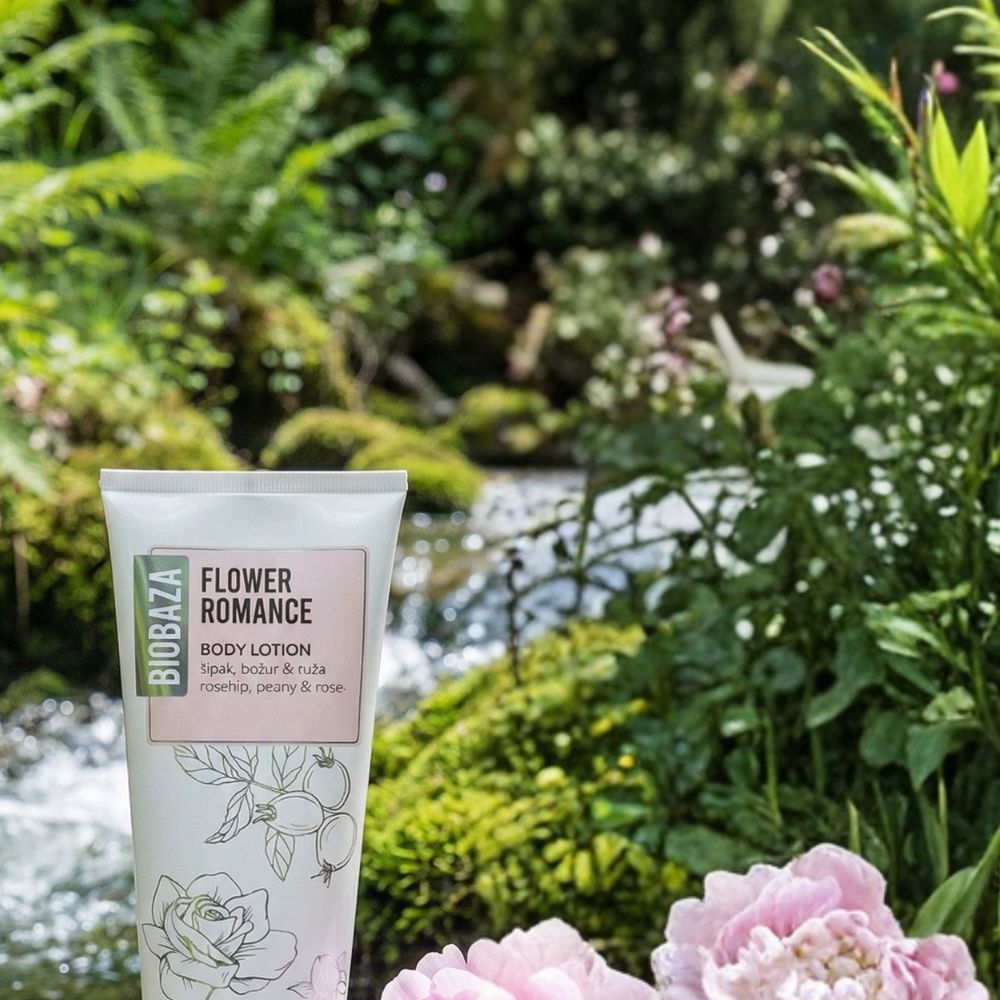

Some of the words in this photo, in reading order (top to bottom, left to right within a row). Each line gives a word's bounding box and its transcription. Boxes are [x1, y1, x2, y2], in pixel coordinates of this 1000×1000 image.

[201, 567, 291, 593] FLOWER
[201, 598, 312, 624] ROMANCE
[148, 568, 182, 686] BIOBAZA
[200, 643, 246, 656] BODY
[251, 643, 311, 656] LOTION
[200, 662, 236, 677] šipak,
[241, 662, 279, 675] božur
[282, 662, 294, 675] &
[298, 663, 326, 675] ruža
[200, 680, 252, 695] rosehip,
[300, 680, 312, 693] &
